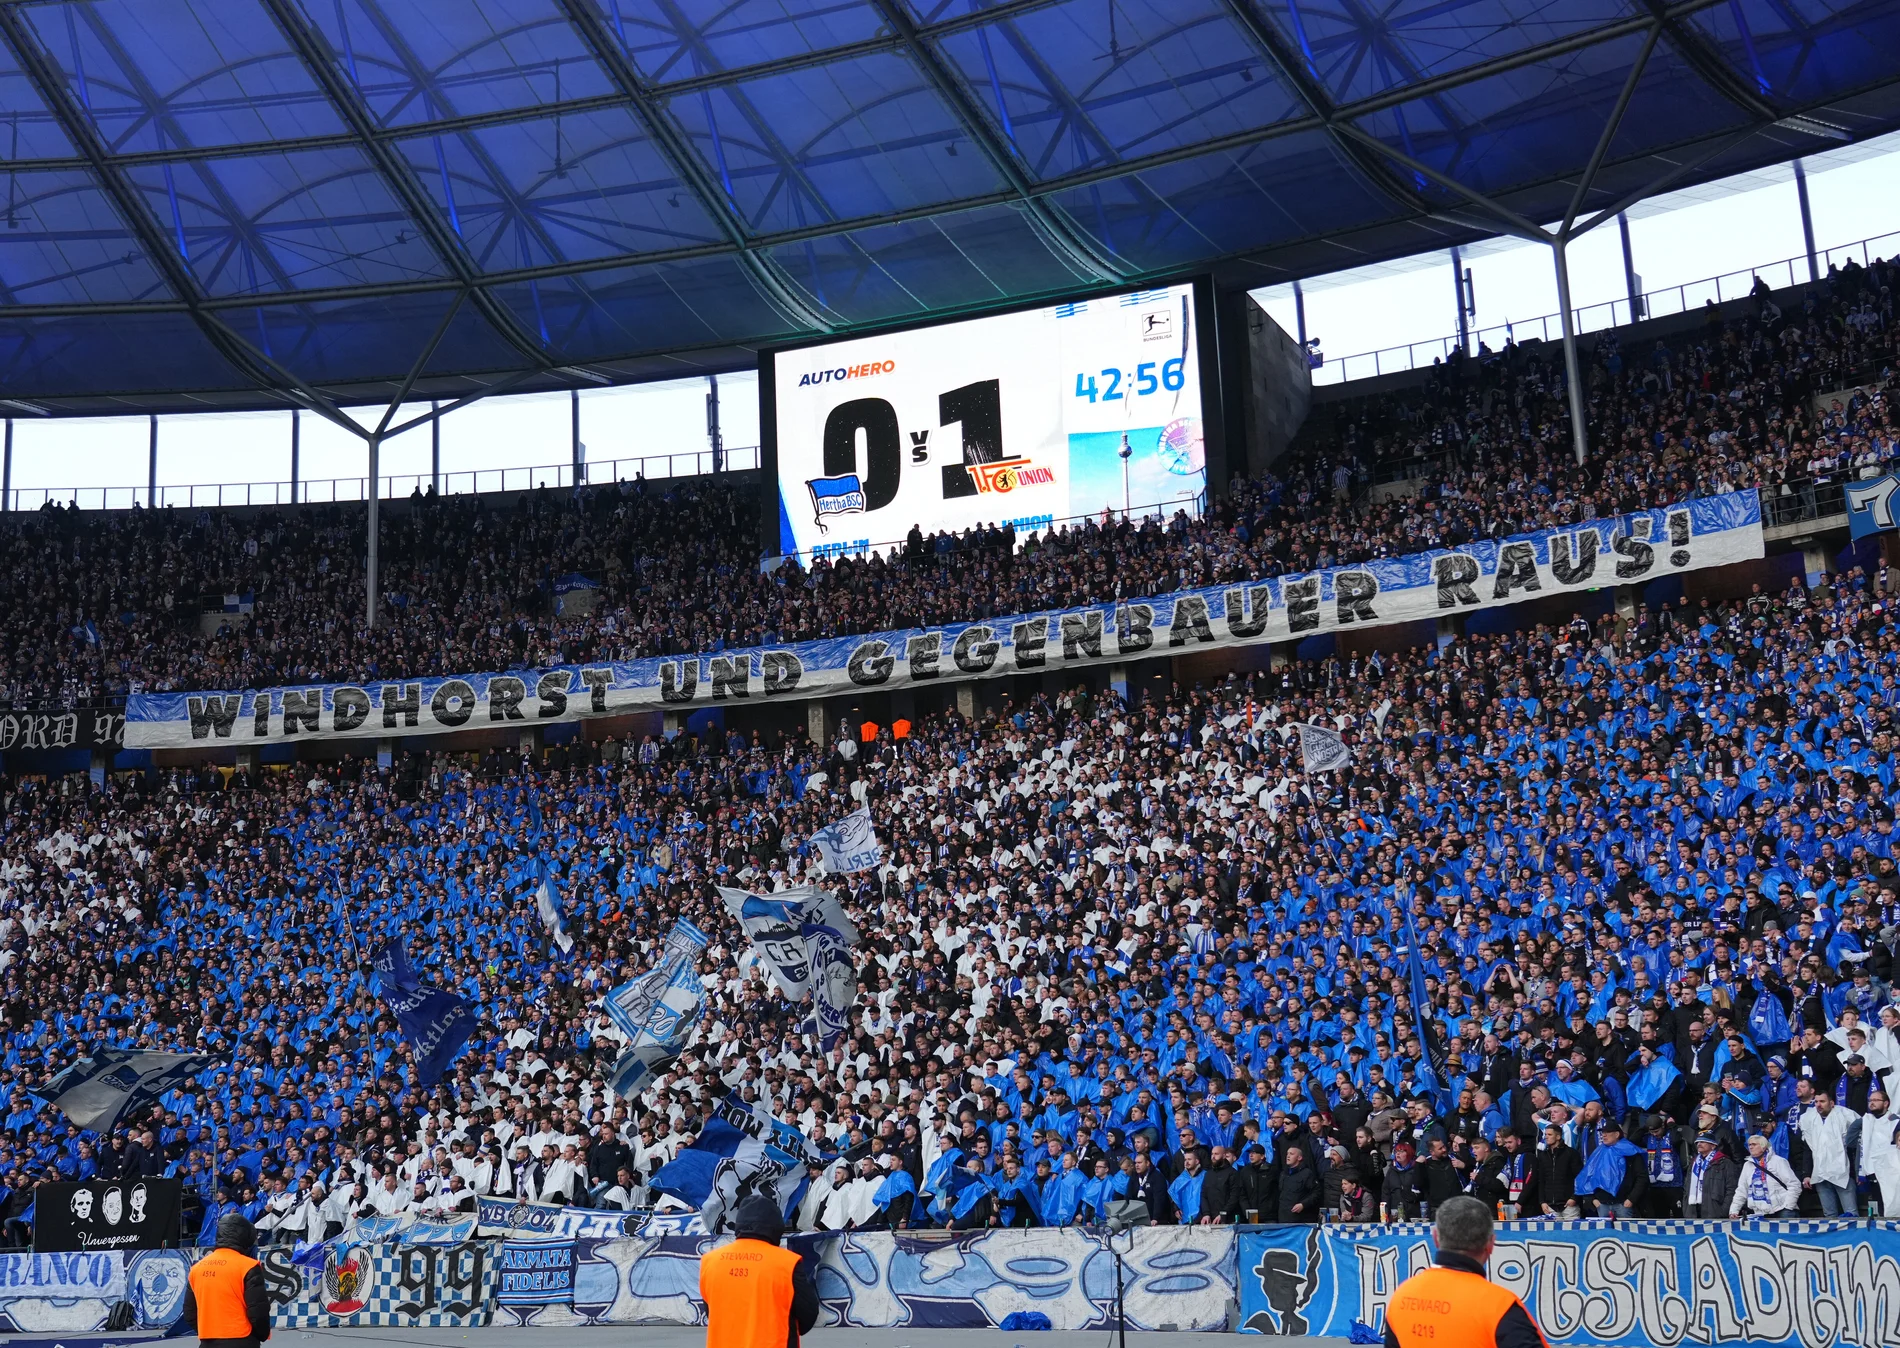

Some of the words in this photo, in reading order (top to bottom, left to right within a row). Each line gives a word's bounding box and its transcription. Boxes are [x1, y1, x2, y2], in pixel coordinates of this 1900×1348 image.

[1143, 334, 1173, 342] BUNDESLIGA
[799, 360, 895, 387] AUTOHERO
[1075, 358, 1185, 404] 42:56
[938, 378, 1021, 500] 1
[823, 397, 901, 513] 0
[1017, 467, 1054, 486] UNION
[187, 669, 614, 739] WINDHORST
[660, 650, 804, 702] UND
[848, 570, 1379, 686] GEGENBAUER
[1436, 508, 1690, 608] RAUS!
[478, 1203, 506, 1225] WB
[78, 1231, 140, 1249] Unvergessen
[501, 1249, 572, 1269] ARMATA
[720, 1252, 763, 1262] STEWARD
[502, 1271, 570, 1291] FIDELIS
[729, 1267, 749, 1278] 4283
[1400, 1297, 1451, 1315] STEWARD
[1412, 1324, 1435, 1339] 4219
